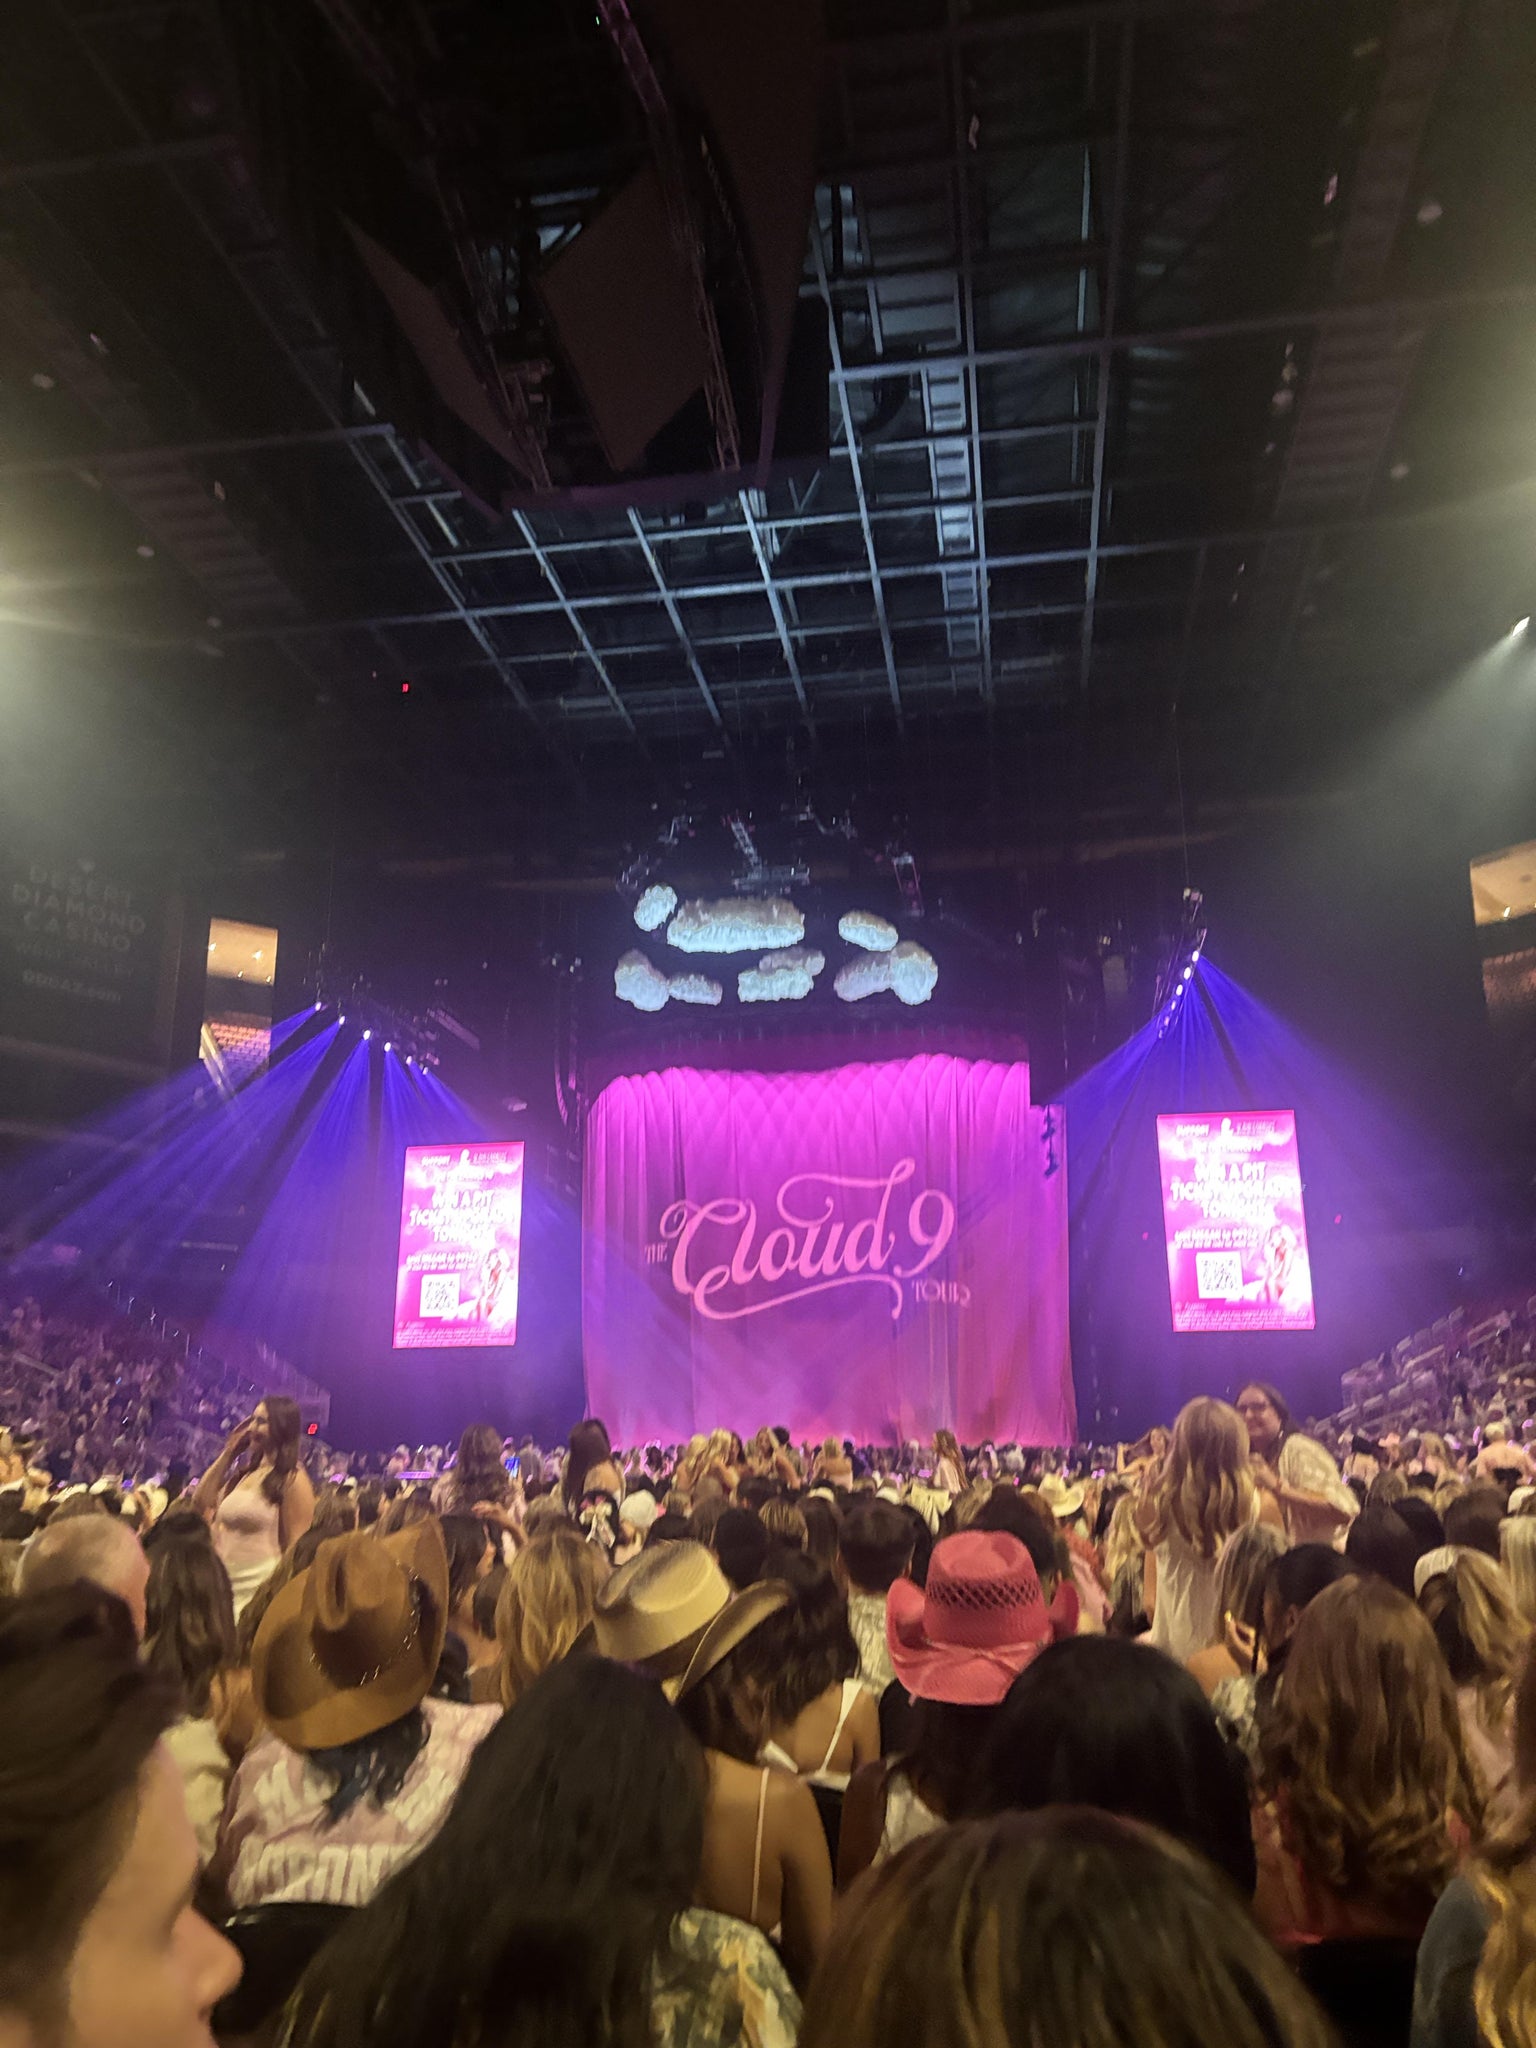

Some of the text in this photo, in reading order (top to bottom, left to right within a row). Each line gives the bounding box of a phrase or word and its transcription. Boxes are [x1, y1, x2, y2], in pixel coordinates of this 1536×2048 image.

[12, 882, 147, 935] DIAMOND
[23, 910, 132, 952] CASINO
[643, 1242, 668, 1265] THE
[660, 1157, 956, 1319] Cloud 9
[912, 1279, 972, 1307] TOUR
